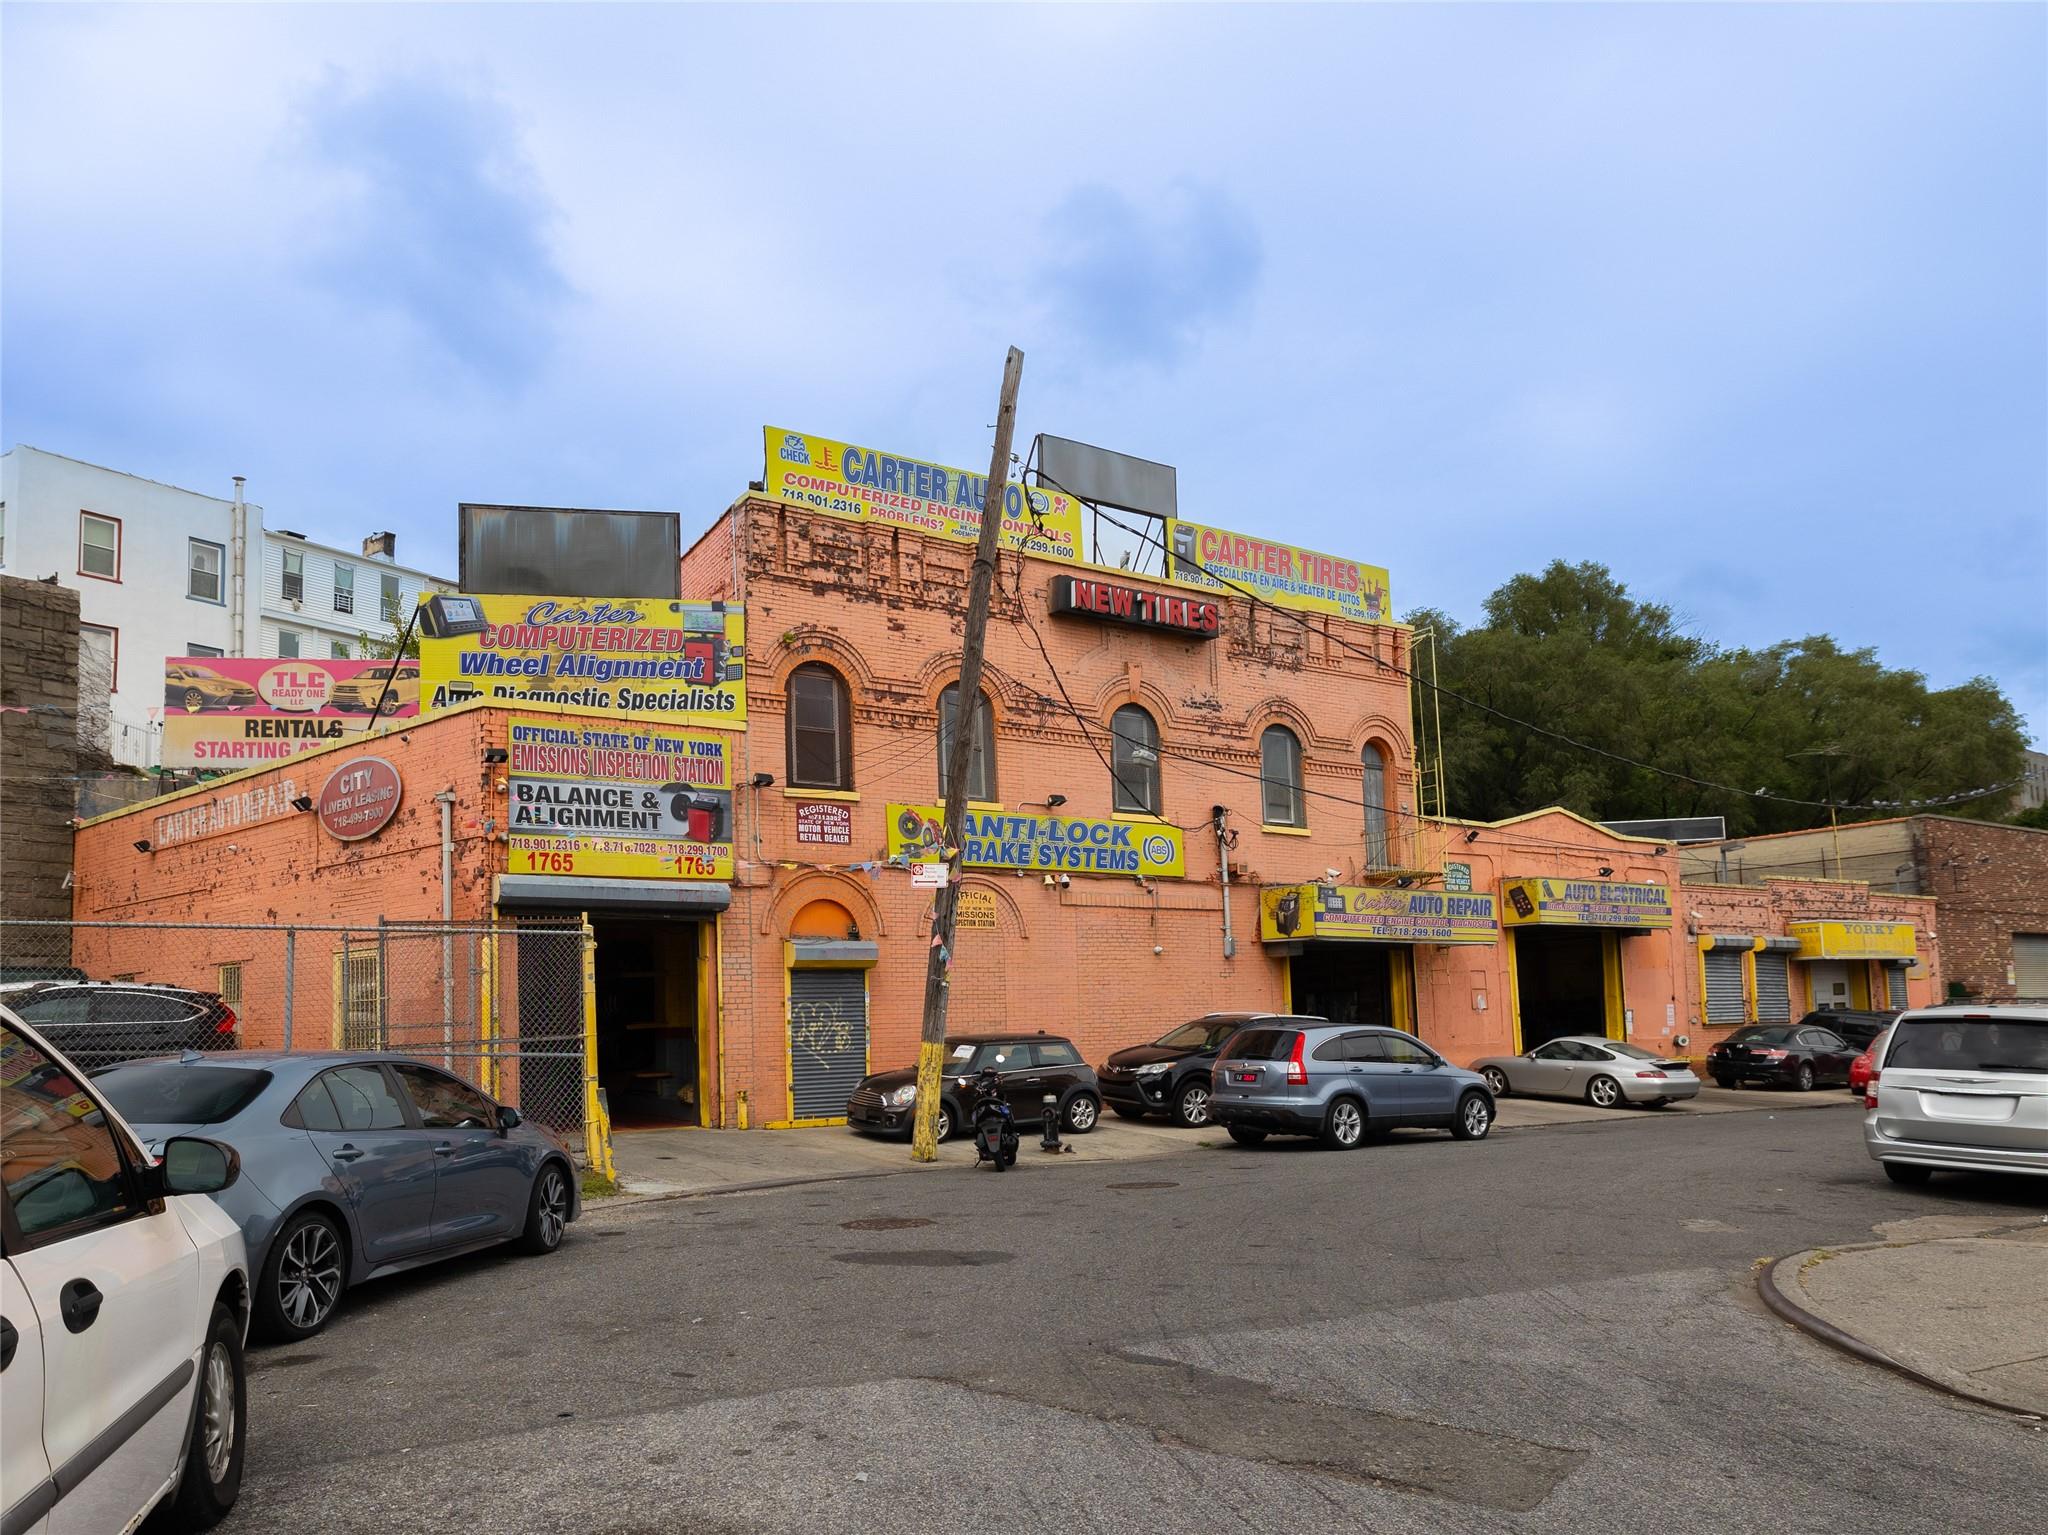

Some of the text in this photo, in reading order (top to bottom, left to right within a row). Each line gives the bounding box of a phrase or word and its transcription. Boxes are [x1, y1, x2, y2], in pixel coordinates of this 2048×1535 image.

[780, 447, 810, 465] CHECK
[784, 472, 922, 511] COMPUTERIZED
[841, 446, 1023, 520] CARTER AUO
[870, 506, 945, 531] PROBLEMS?
[1009, 535, 1074, 558] 718.299.1600
[1201, 528, 1360, 593] CARTER TIRES
[1175, 571, 1224, 589] 718.901.2316
[1204, 563, 1361, 606] ESPECIALISTA EN AIRE & HEATER DE AUTOS
[526, 601, 645, 627] Carter
[1071, 579, 1218, 631] NEW TIRES
[479, 623, 684, 653] COMPUTERIZED
[272, 671, 325, 688] TLC
[459, 653, 705, 682] Wheel Alignment
[271, 688, 325, 699] READY ONE
[617, 688, 736, 712] Specialists
[244, 719, 343, 739] RENTALS
[512, 725, 723, 757] OFFICIAL STATE OF NEW YORK
[193, 740, 291, 759] STARTING
[511, 743, 725, 785] EMISSIONS INSPECTION STATION
[339, 766, 374, 794] CITY
[323, 785, 394, 816] LIVERY LEASING
[516, 783, 660, 810] BALANCE &
[158, 779, 297, 845] CARTER AUTO REPAIR
[515, 805, 662, 831] ALIGNMENT
[799, 804, 849, 819] REGISTERED
[798, 824, 850, 835] MOTOR VEHICLE
[799, 832, 849, 843] RETAIL DEALER
[964, 814, 1134, 846] ANTI-LOCK
[510, 837, 581, 851] 718.901.2316
[667, 843, 728, 857] 718.299.1700
[960, 840, 1139, 871] RAKE SYSTEMS
[1151, 844, 1167, 856] ABS
[527, 852, 716, 876] 1765 1765
[957, 891, 992, 904] FFICIAL
[1409, 895, 1443, 917] AUTO
[1446, 897, 1493, 918] REPAIR
[1564, 883, 1668, 906] AUTO ELECTRICAL
[956, 911, 995, 919] MISSIONS
[1323, 912, 1493, 930] COMPUTERIZED ENGINE CONTROL DIAGNOSTIC
[1371, 925, 1452, 938] TEL: 718.299.1600
[1843, 924, 1895, 935] YORKY
